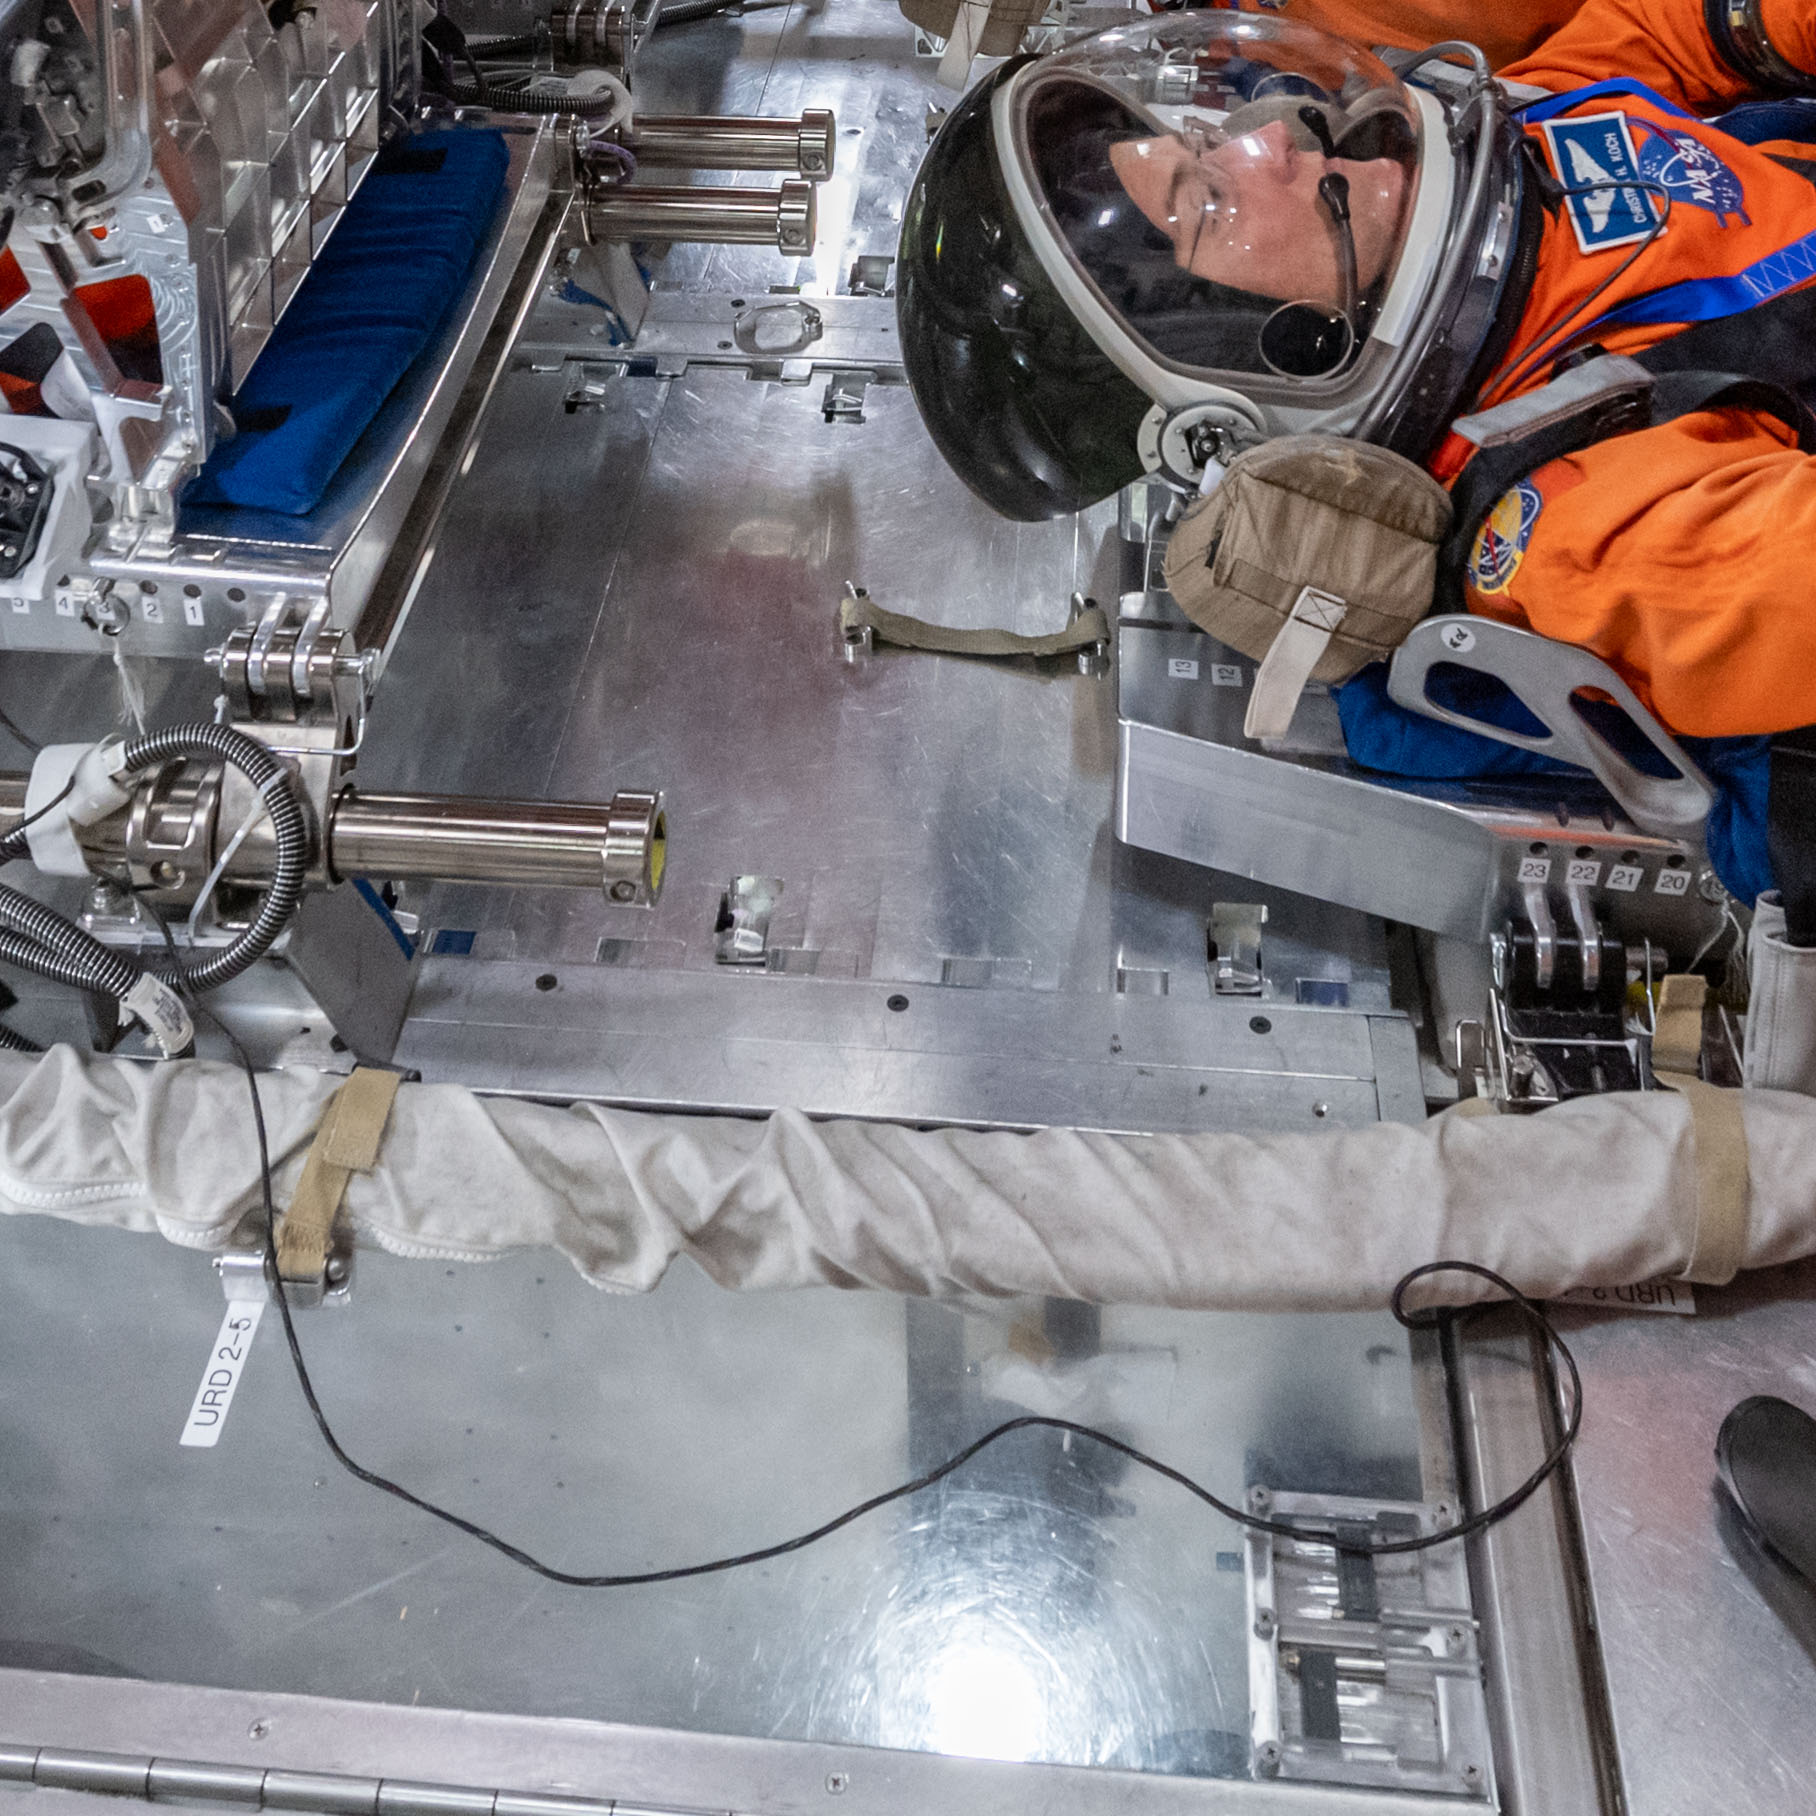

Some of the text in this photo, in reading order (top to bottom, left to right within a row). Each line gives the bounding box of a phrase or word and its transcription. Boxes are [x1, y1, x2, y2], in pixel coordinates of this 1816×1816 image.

[1604, 132, 1624, 163] KOCH
[1674, 138, 1717, 205] NASA
[1620, 177, 1648, 224] CHRISTI
[57, 596, 70, 611] 4
[99, 602, 111, 615] 3
[146, 602, 159, 617] 2
[190, 606, 198, 620] 1
[1175, 661, 1192, 673] 13
[1218, 667, 1234, 681] 12
[1524, 862, 1546, 878] 23
[1571, 864, 1595, 880] 22
[1612, 870, 1636, 885] 21
[1660, 875, 1684, 890] 20
[1614, 1286, 1675, 1305] URD
[193, 1318, 252, 1426] URD 2-5
